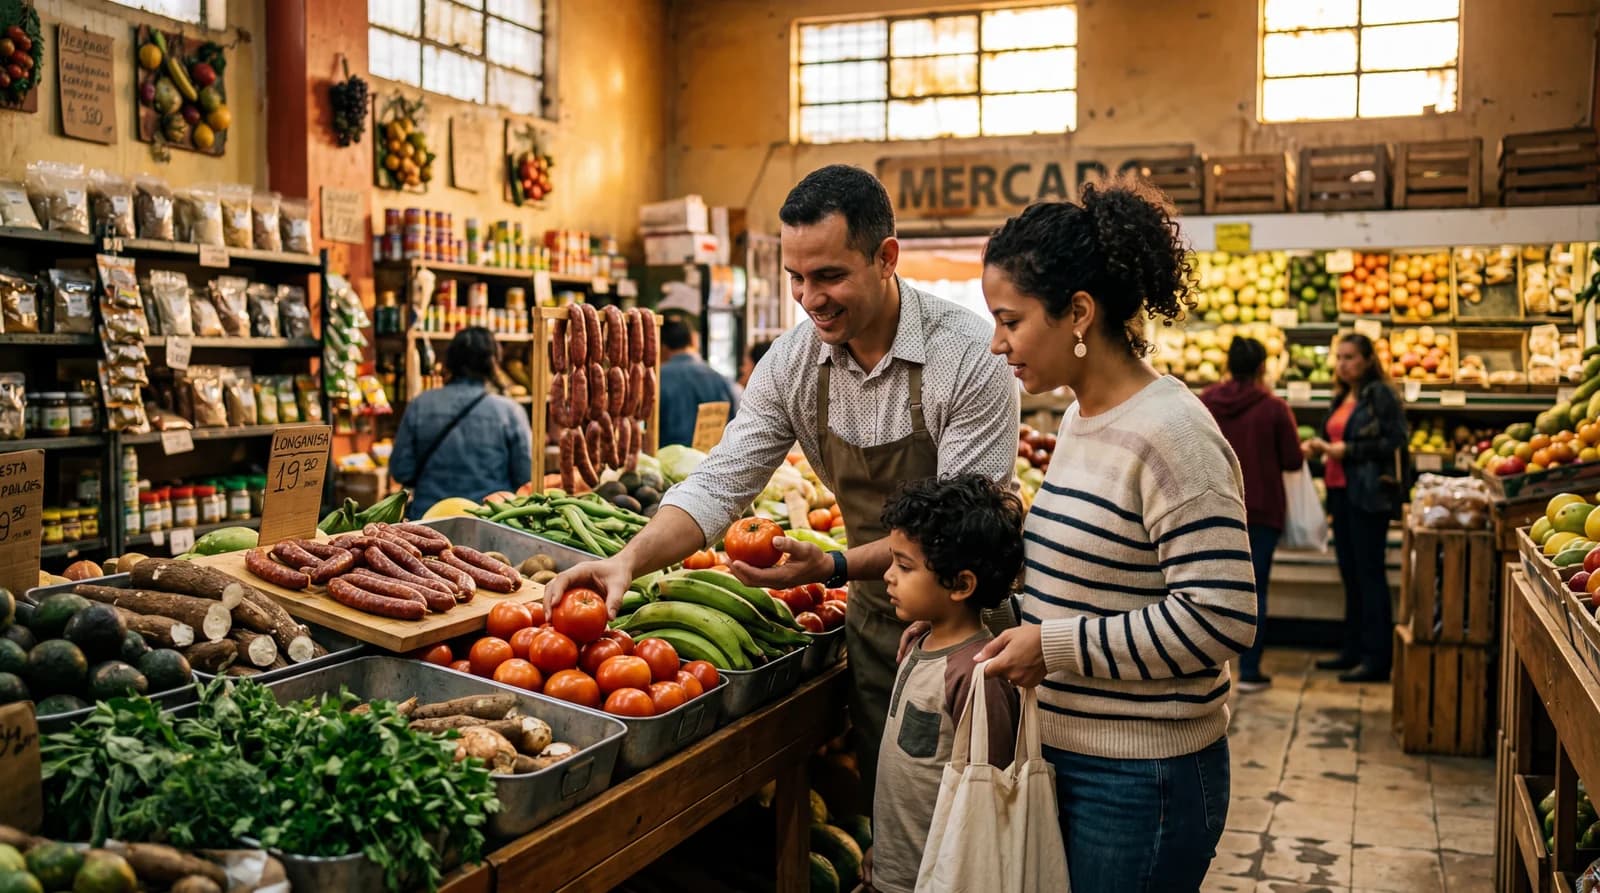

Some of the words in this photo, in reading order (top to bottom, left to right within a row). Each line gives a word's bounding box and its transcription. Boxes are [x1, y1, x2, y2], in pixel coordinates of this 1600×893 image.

[899, 160, 1139, 208] MERCAD
[274, 433, 328, 451] LONGANISA
[273, 460, 300, 492] 19
